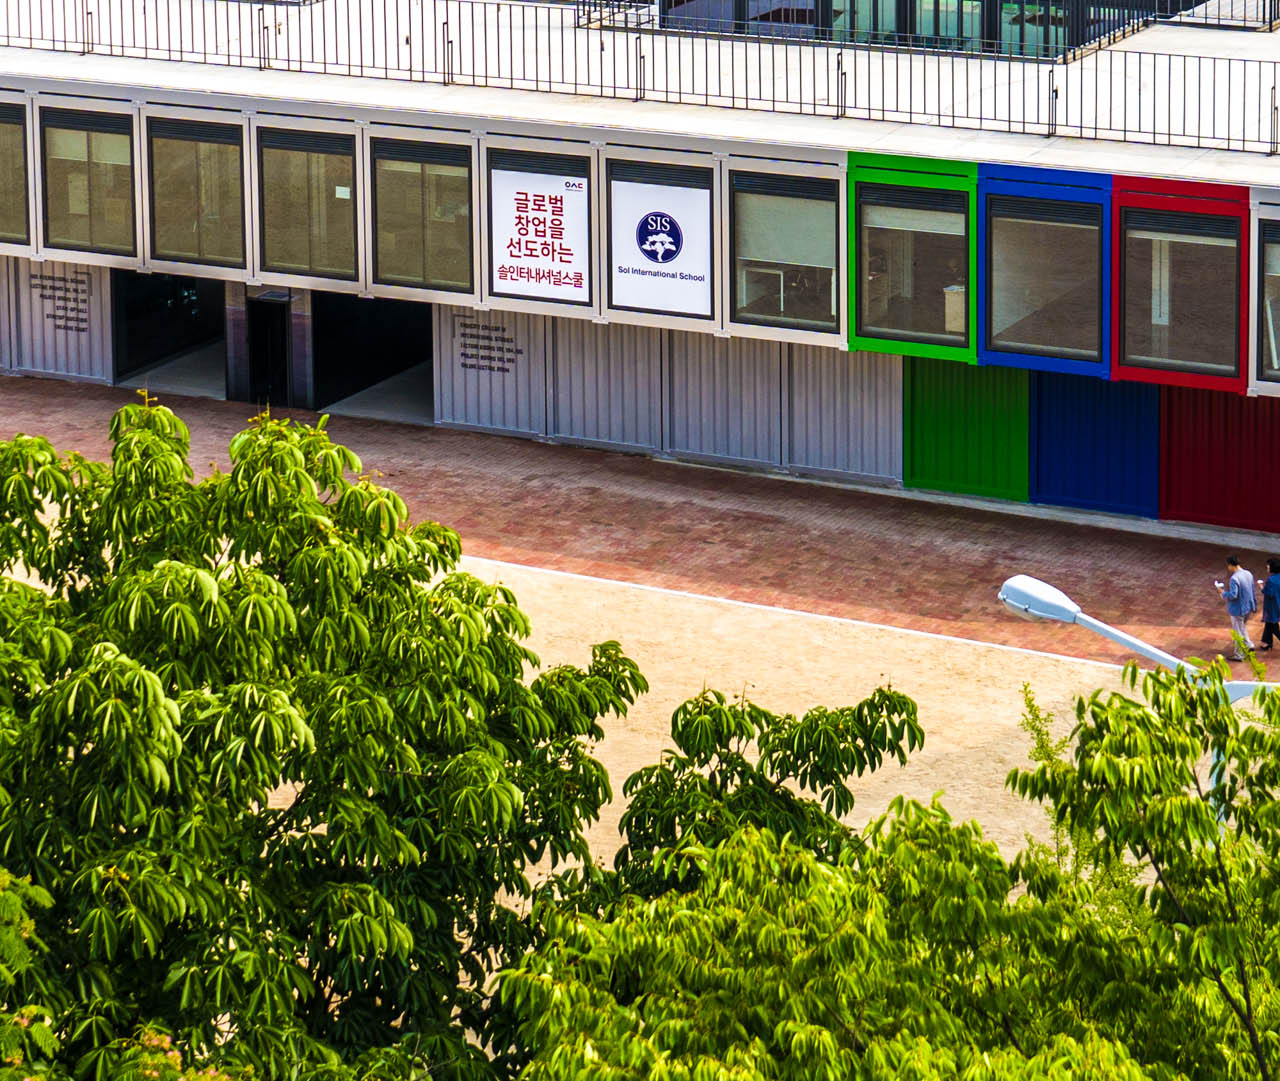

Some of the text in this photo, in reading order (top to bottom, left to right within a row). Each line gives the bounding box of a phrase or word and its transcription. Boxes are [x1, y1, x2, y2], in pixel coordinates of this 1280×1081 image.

[514, 192, 564, 216] 글로벌
[514, 214, 565, 240] 창업을
[647, 216, 671, 232] SIS
[506, 237, 574, 264] 선도하는
[497, 264, 584, 289] 솔인터내셔널스쿨
[618, 265, 705, 282] Sol International School
